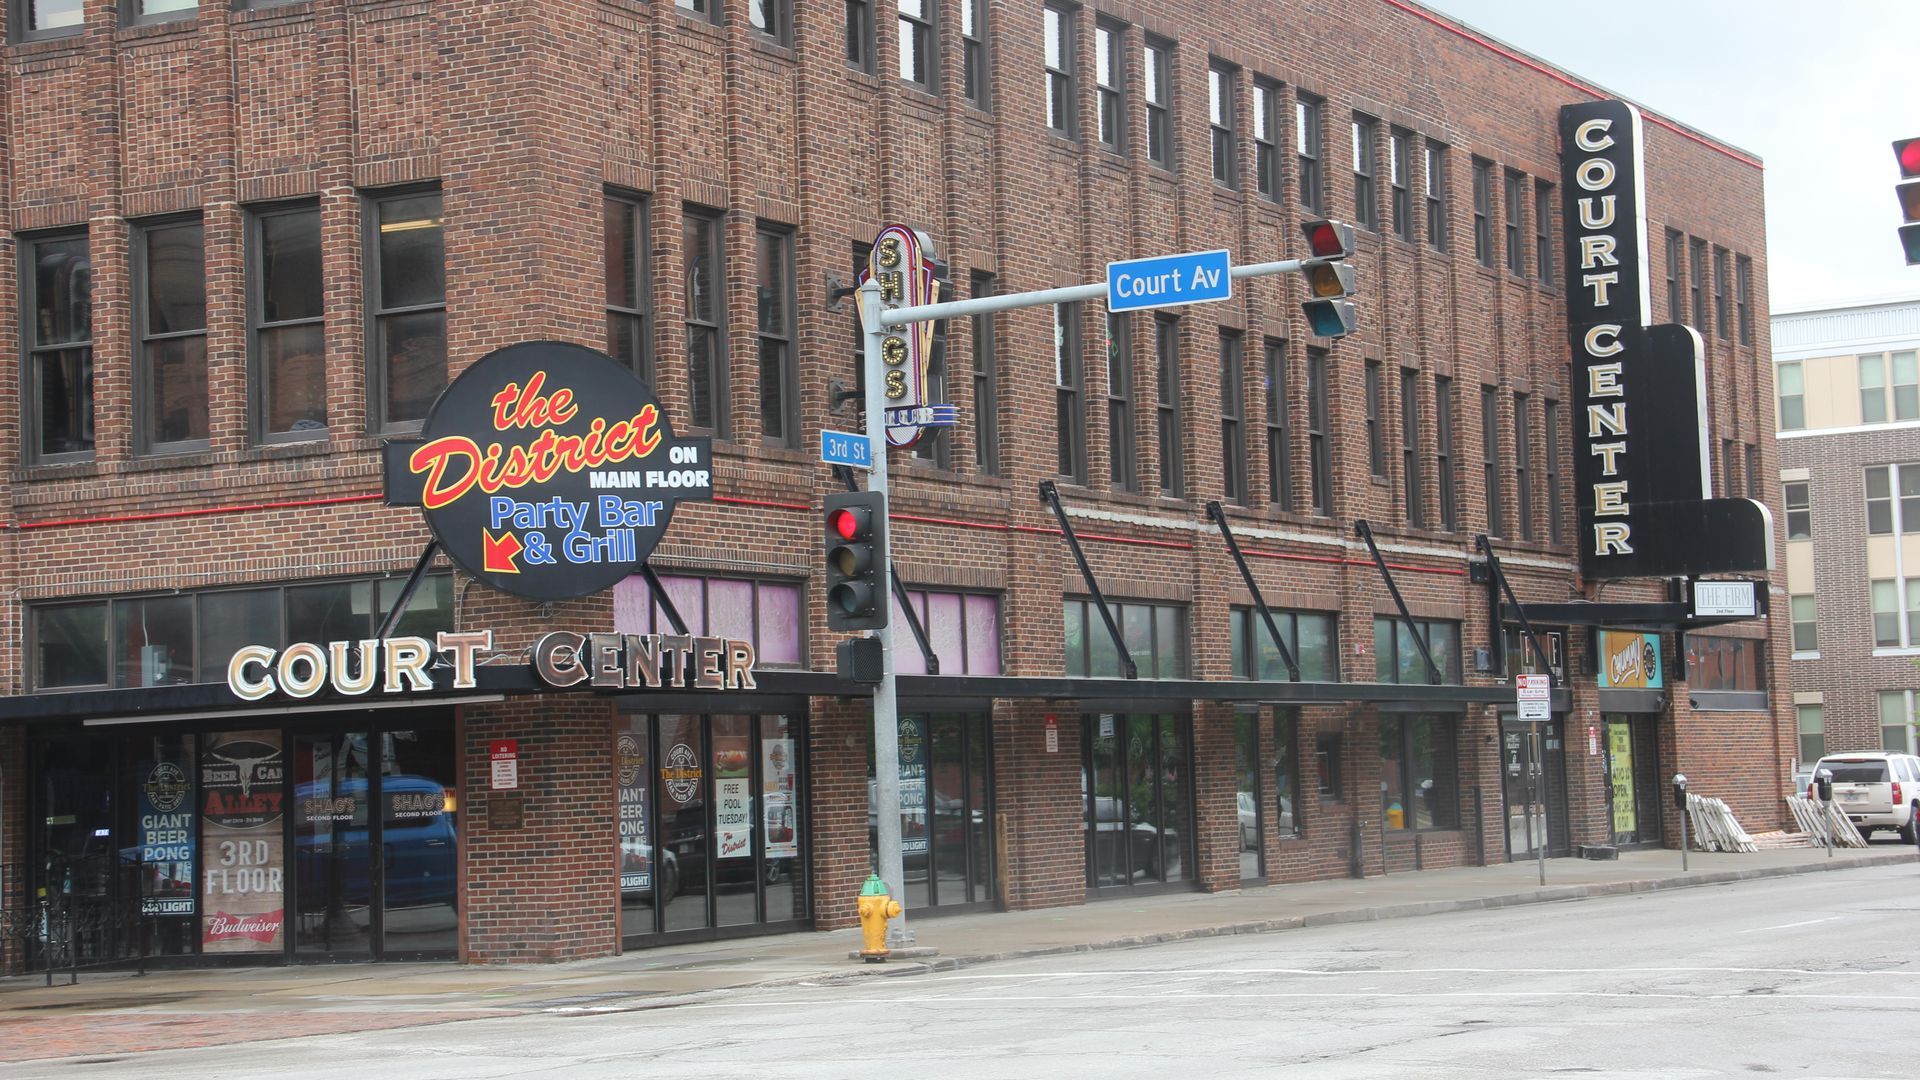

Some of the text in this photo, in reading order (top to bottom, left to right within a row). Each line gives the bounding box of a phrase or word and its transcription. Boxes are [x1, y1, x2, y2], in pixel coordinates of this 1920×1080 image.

[1574, 118, 1620, 307] COURT
[1116, 265, 1221, 298] Court Av
[490, 370, 579, 431] the
[884, 407, 935, 426] LUB
[1584, 323, 1634, 556] CENTER
[409, 403, 662, 509] District
[669, 446, 698, 464] ON
[829, 438, 865, 460] 3rd St
[589, 470, 710, 489] MAIN FLOOR
[490, 494, 663, 533] Party Bar
[523, 528, 637, 566] & Grill
[1700, 587, 1750, 606] THE FIRM
[227, 630, 757, 700] COURT CENTER
[1517, 678, 1527, 687] NO
[491, 752, 516, 760] LOITERING
[202, 768, 238, 783] BEER
[660, 767, 703, 779] The District
[618, 787, 645, 802] IANT
[722, 784, 740, 795] FREE
[204, 790, 283, 815] ALLEY
[303, 797, 356, 814] SHAG'S
[392, 793, 444, 811] SHAG'S
[723, 799, 742, 809] POOL
[141, 813, 193, 829] GIANT
[618, 804, 643, 820] EER
[619, 820, 645, 835] ONG
[724, 831, 733, 841] The
[146, 830, 188, 845] BEER
[721, 838, 746, 855] District
[144, 846, 190, 861] PONG
[220, 840, 269, 867] 3RD
[206, 867, 283, 895] FLOOR
[626, 874, 649, 888] LIGHT
[162, 901, 193, 912] LIGHT
[207, 917, 281, 935] Budweiser
